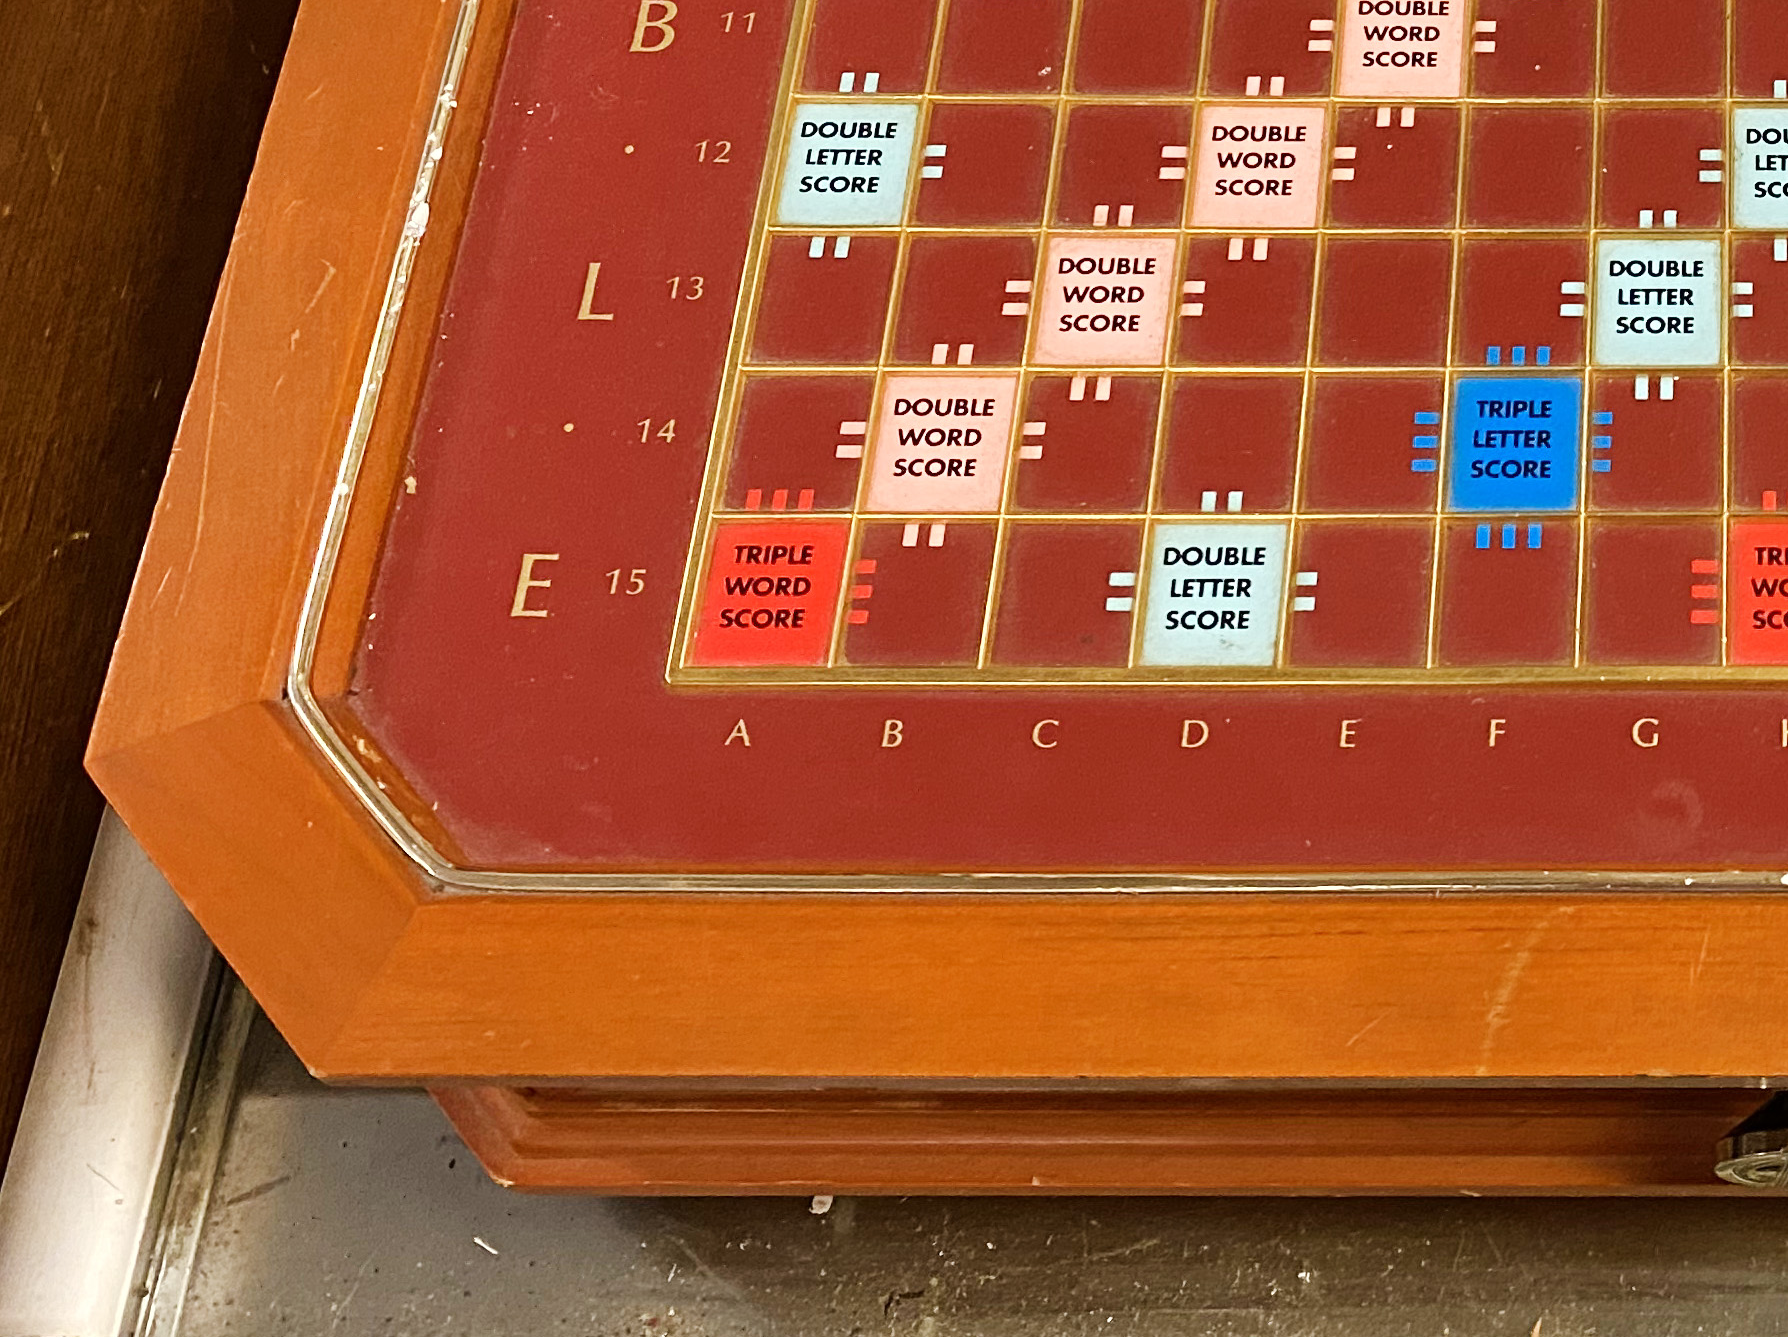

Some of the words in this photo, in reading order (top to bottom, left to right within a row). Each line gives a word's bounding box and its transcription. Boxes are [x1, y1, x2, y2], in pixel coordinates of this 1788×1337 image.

[1357, 0, 1451, 17] DOUBLE
[720, 10, 757, 35] 11
[1362, 24, 1441, 43] WORD
[1361, 50, 1439, 69] SCORE
[694, 139, 733, 165] 12
[666, 275, 705, 302] 13
[893, 397, 997, 418] DOUBLE
[636, 417, 677, 444] 14
[897, 427, 983, 448] WORD
[892, 457, 978, 478] SCORE
[734, 544, 814, 566] TRIPLE
[605, 567, 648, 596] 15
[724, 576, 812, 598] WORD
[718, 608, 806, 630] SCORE
[723, 717, 752, 748] A
[880, 718, 905, 749] B
[1031, 718, 1061, 750] C
[1180, 718, 1210, 749] D
[1338, 717, 1362, 749] E
[1487, 717, 1508, 748] F
[1631, 716, 1660, 749] G
